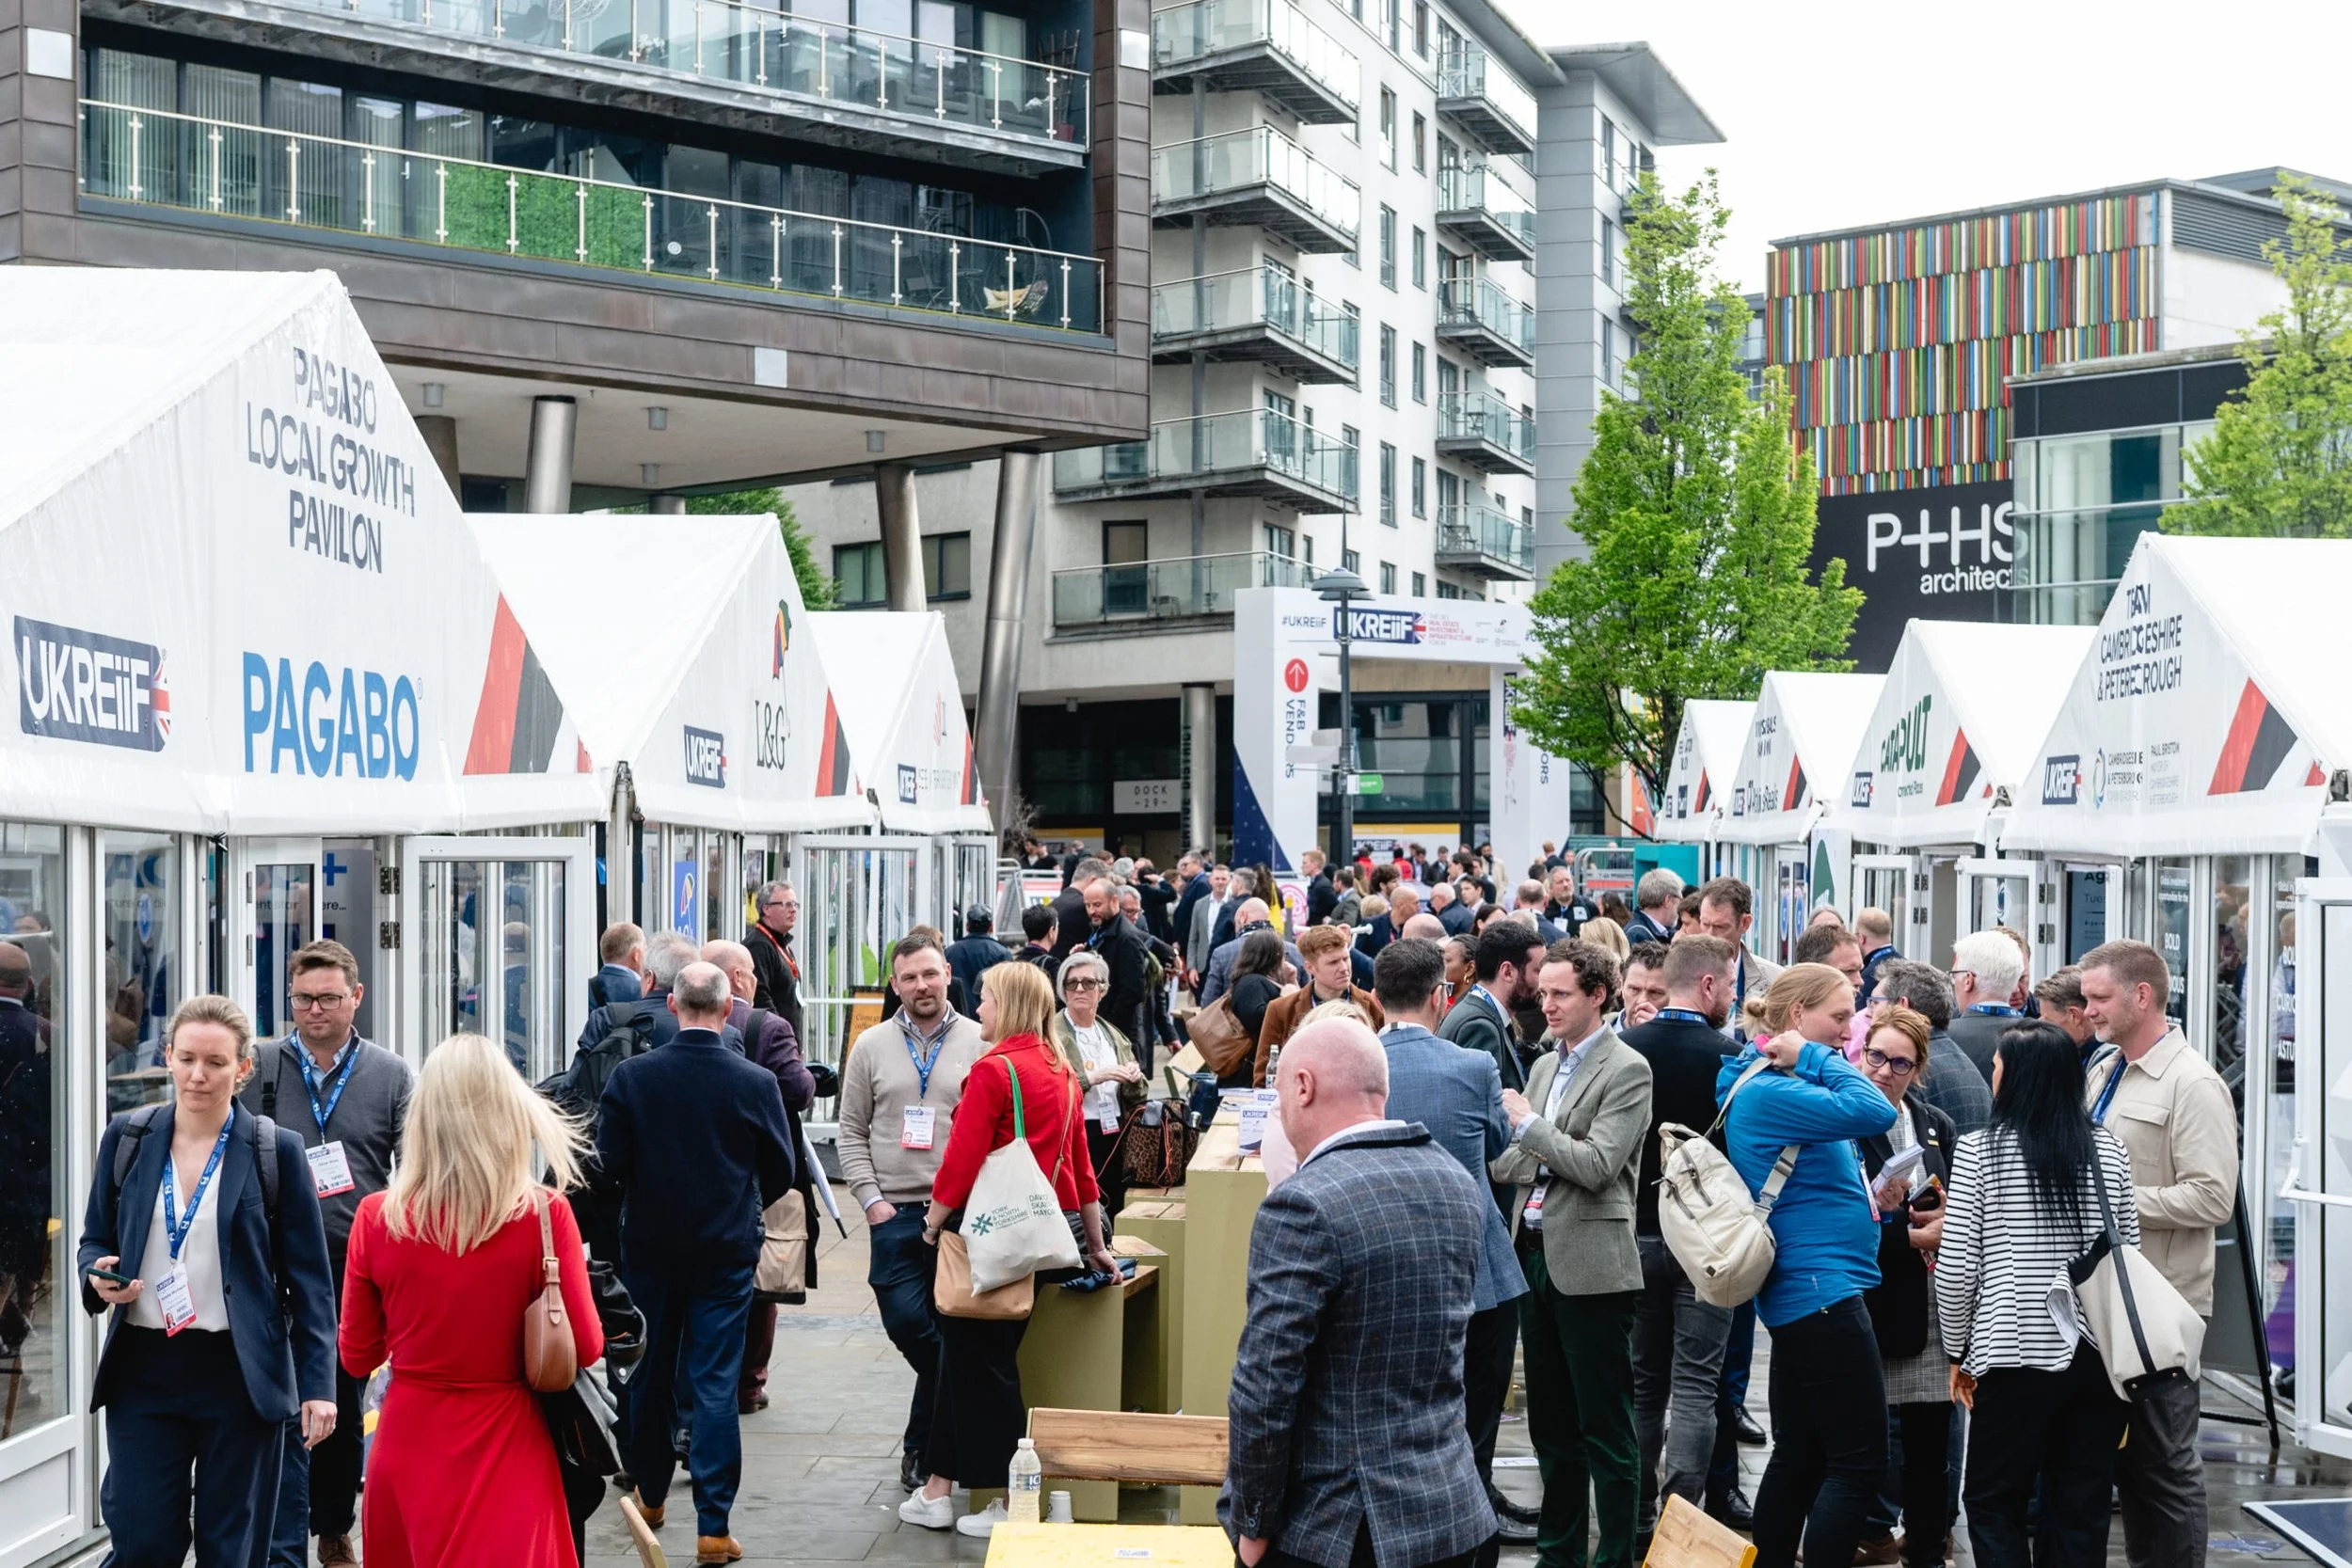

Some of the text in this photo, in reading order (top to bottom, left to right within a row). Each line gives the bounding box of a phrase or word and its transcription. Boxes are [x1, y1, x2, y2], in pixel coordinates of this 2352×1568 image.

[294, 346, 376, 435] PAGABO
[247, 401, 415, 517] LOCAL GROWTH
[1867, 500, 2029, 573] P+HS
[1282, 616, 1327, 628] #UKREiiF
[23, 635, 151, 734] UKREiiF
[242, 651, 420, 783] PAGABO
[1297, 699, 1306, 731] F&B
[755, 699, 787, 771] L&G
[1881, 694, 1931, 773] CATAPULT
[1134, 784, 1168, 796] DOCK
[2164, 932, 2181, 951] BOLD
[2282, 945, 2296, 966] BOL
[2277, 1039, 2296, 1062] ASTU
[991, 1205, 1009, 1215] YORK
[993, 1210, 1028, 1227] YORKSHIRE
[997, 1208, 1020, 1220] NORTH
